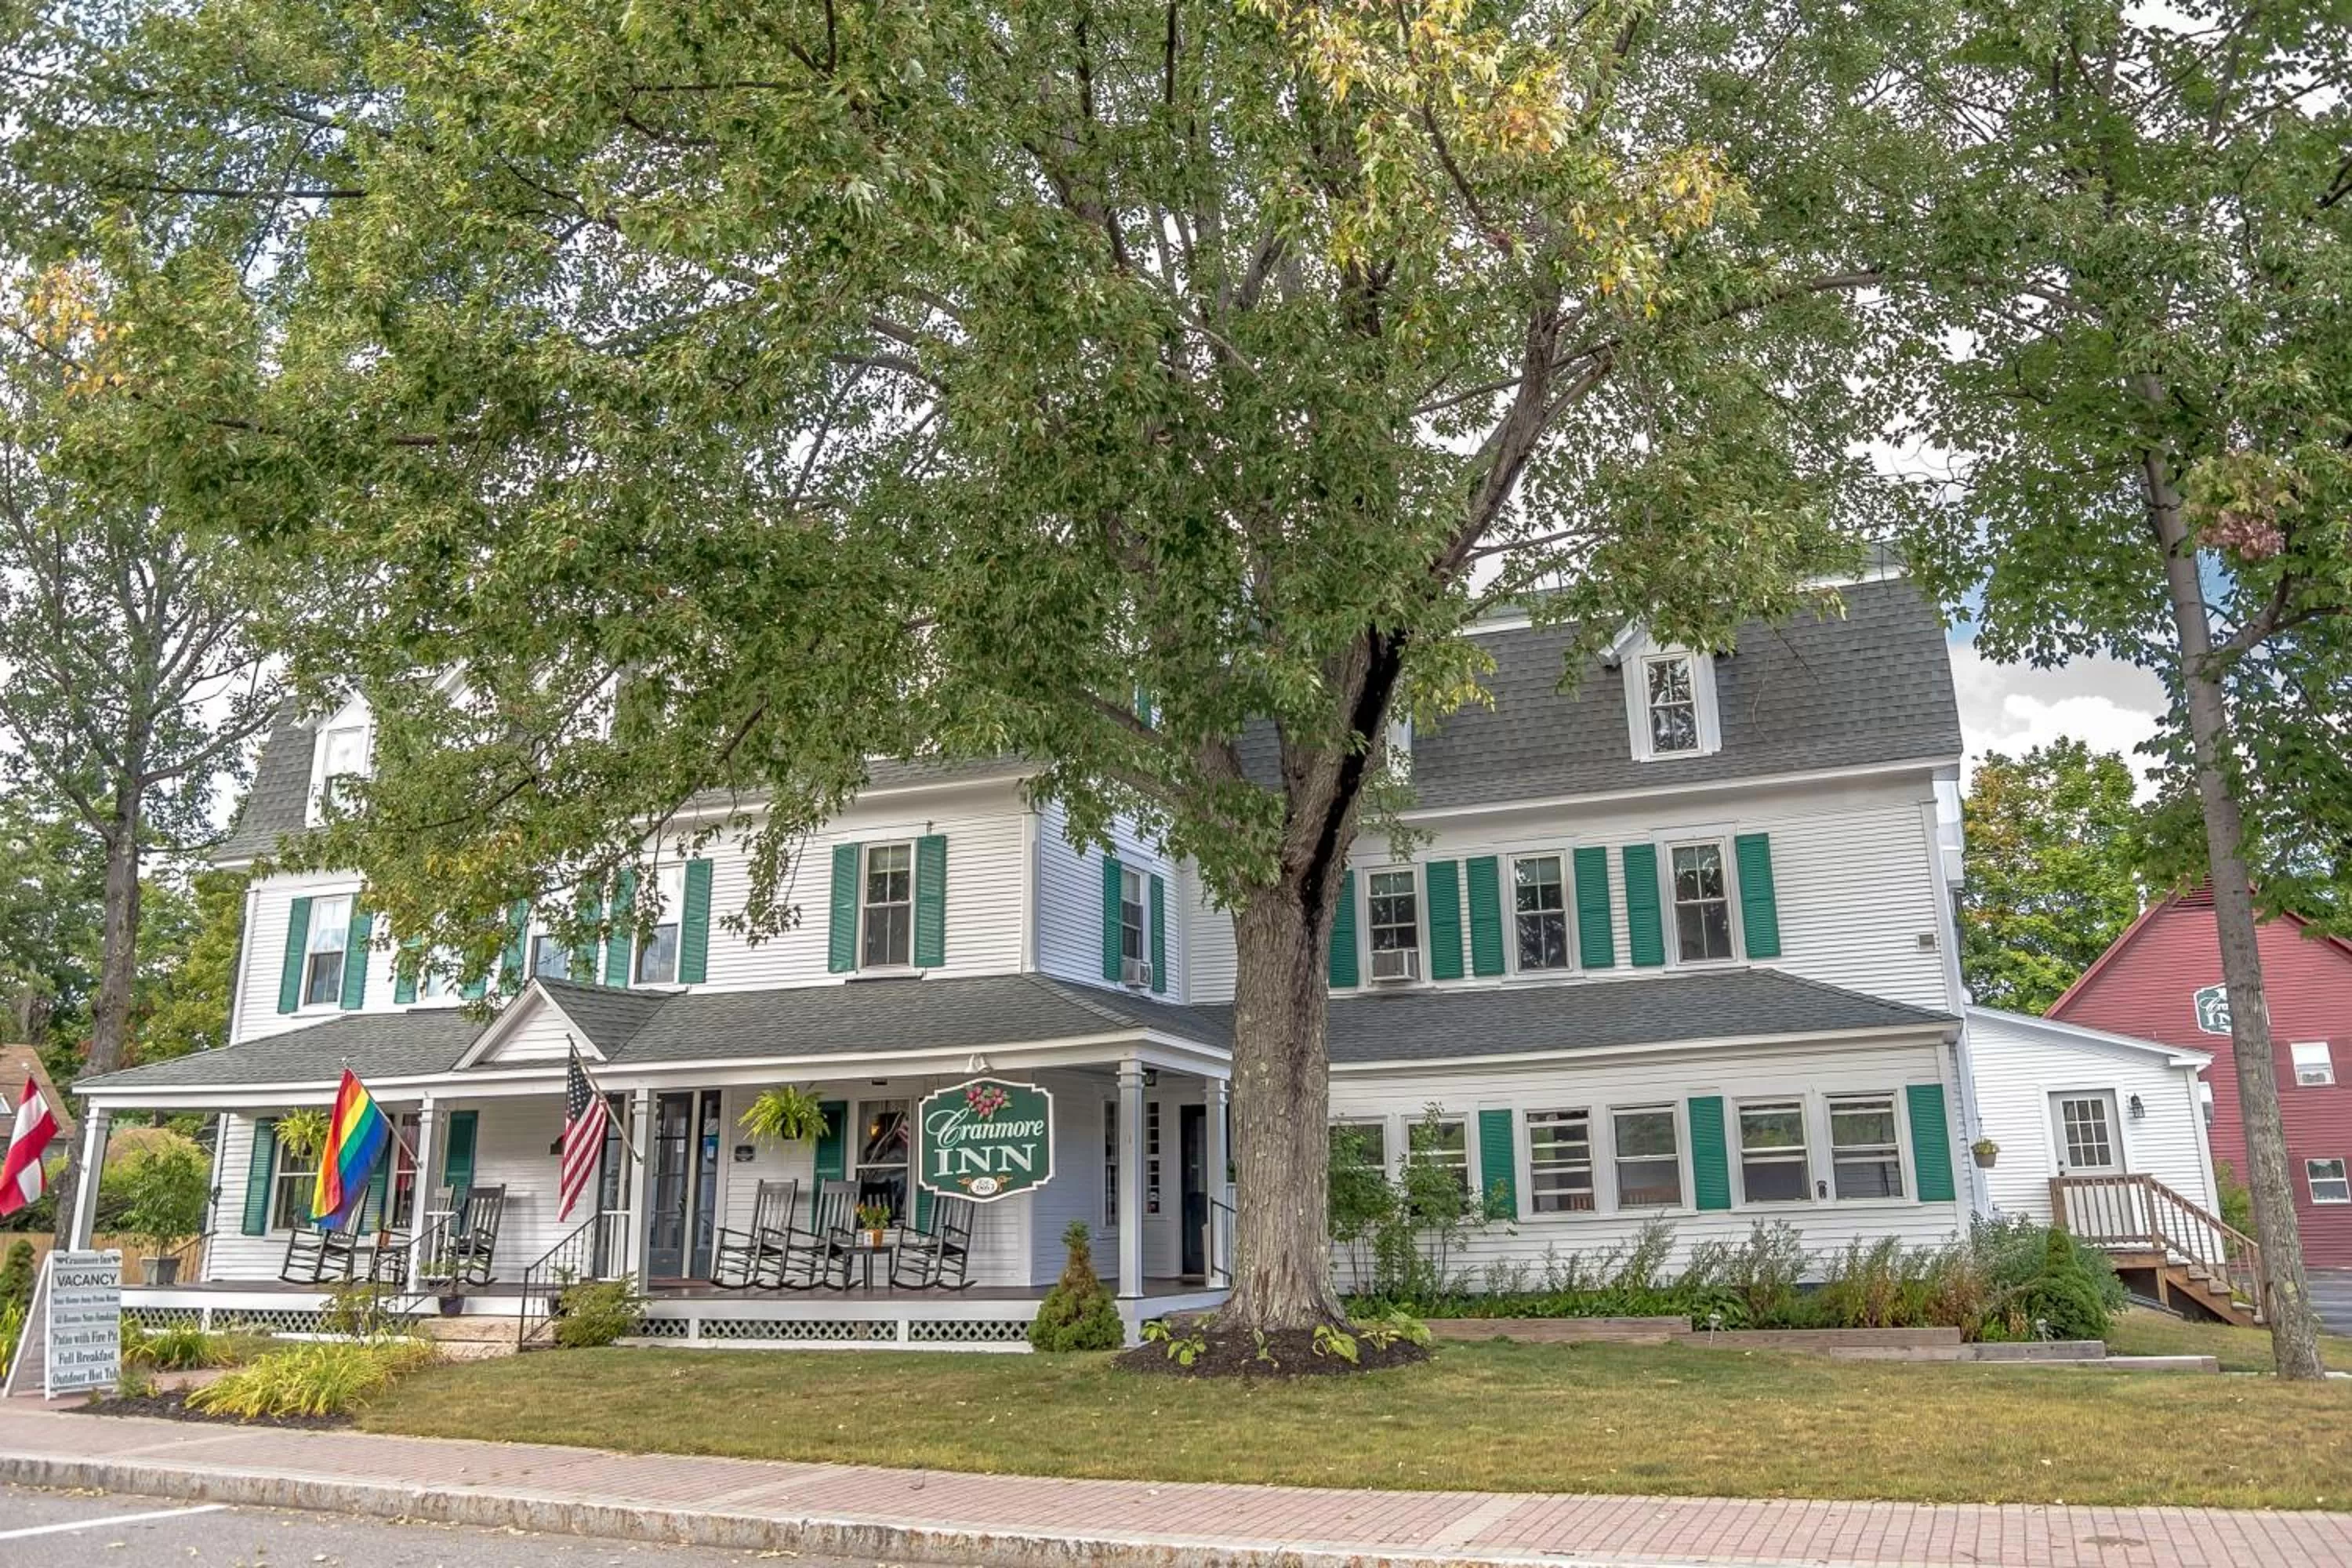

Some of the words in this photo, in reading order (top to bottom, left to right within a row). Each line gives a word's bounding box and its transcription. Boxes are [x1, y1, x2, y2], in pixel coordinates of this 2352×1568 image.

[925, 1108, 1044, 1148] Cranmore
[934, 1143, 1037, 1177] INN
[100, 1254, 111, 1264] Inn
[57, 1272, 117, 1287] VACANCY
[53, 1334, 73, 1345] Patio
[74, 1331, 89, 1344] with
[92, 1330, 106, 1342] Fire
[59, 1352, 74, 1364] Full
[76, 1348, 115, 1363] Breakfast
[53, 1371, 86, 1385] Outdoor
[89, 1369, 103, 1381] Hot
